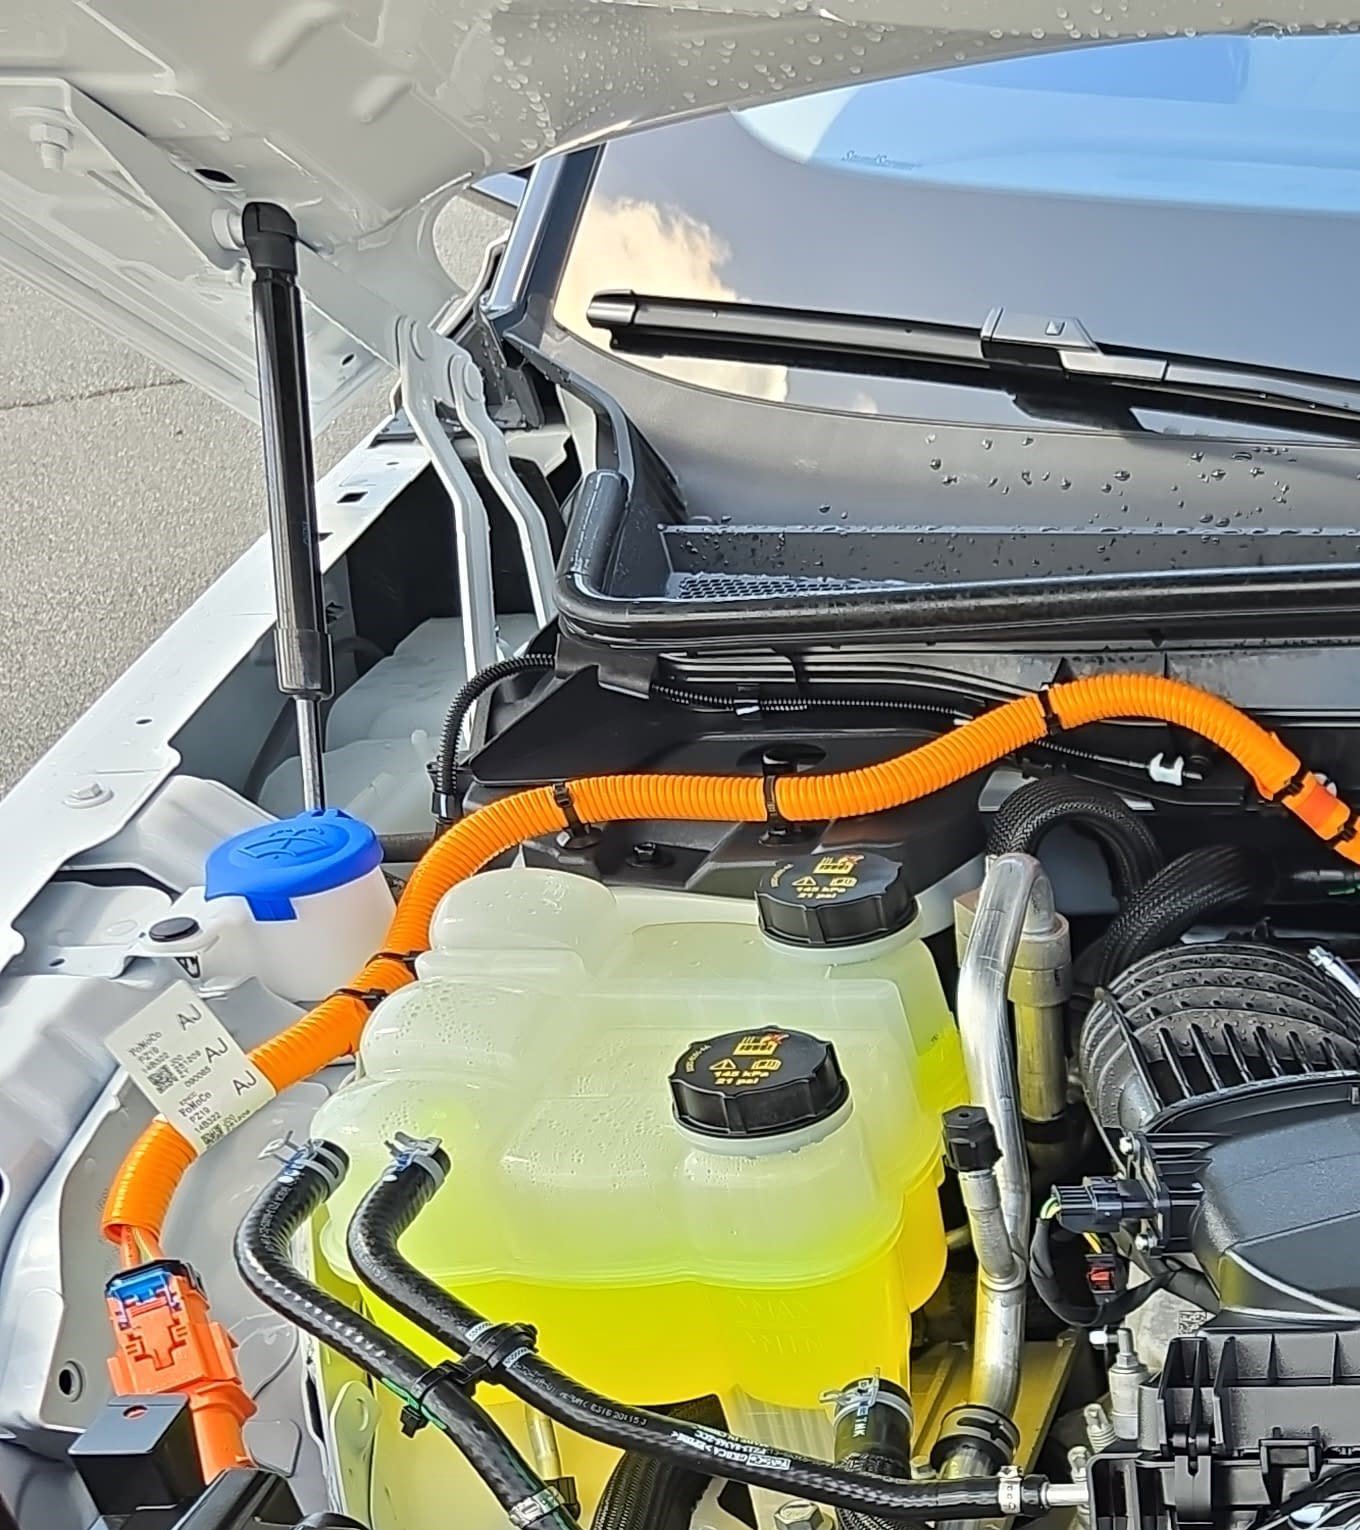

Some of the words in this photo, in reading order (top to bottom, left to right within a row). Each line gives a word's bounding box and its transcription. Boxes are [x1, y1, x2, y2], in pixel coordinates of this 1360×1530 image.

[177, 1004, 202, 1031] AJ
[128, 1031, 162, 1057] FoMoCo
[205, 1037, 229, 1063] AJ
[232, 1070, 257, 1096] AJ
[178, 1091, 212, 1117] FoMoCo
[189, 1107, 211, 1123] PZ19
[194, 1111, 222, 1134] 14B322
